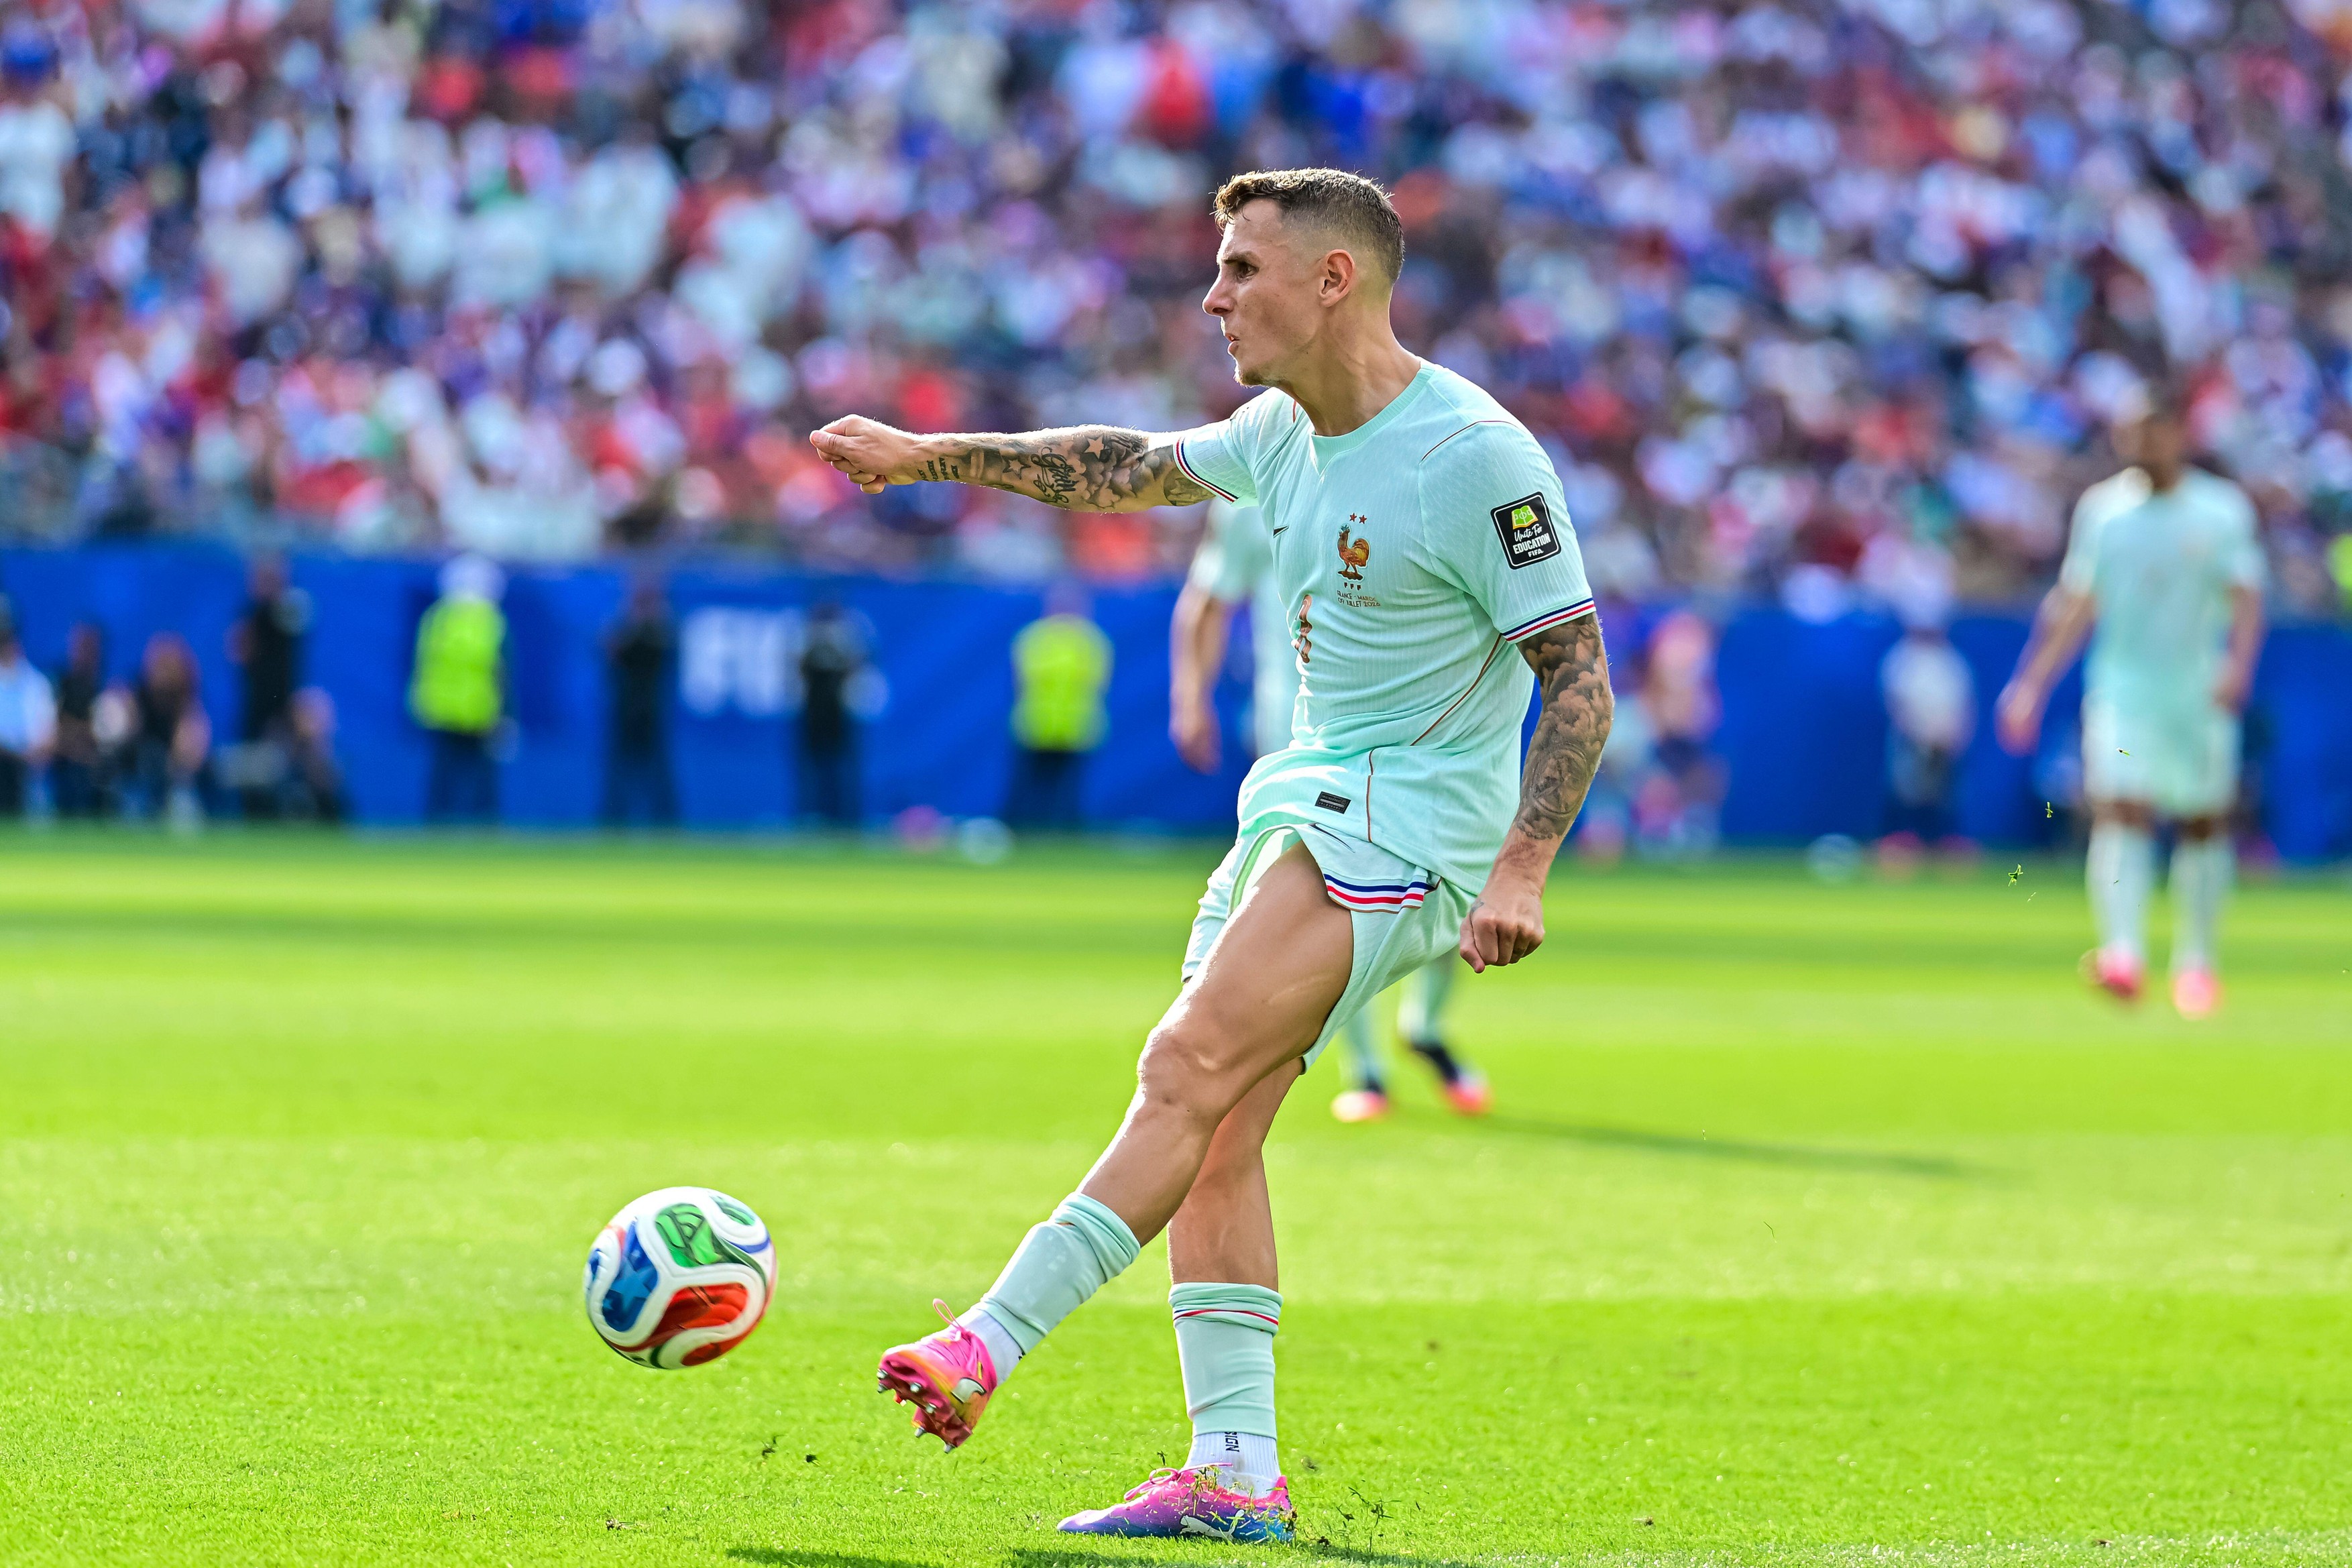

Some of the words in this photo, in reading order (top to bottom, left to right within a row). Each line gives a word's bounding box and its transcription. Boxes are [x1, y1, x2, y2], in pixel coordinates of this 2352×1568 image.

[1514, 528, 1533, 542] Unite
[1532, 524, 1543, 536] For
[1512, 533, 1551, 555] EDUCATION
[1528, 548, 1544, 557] FIFA
[1337, 590, 1353, 600] FRANCE
